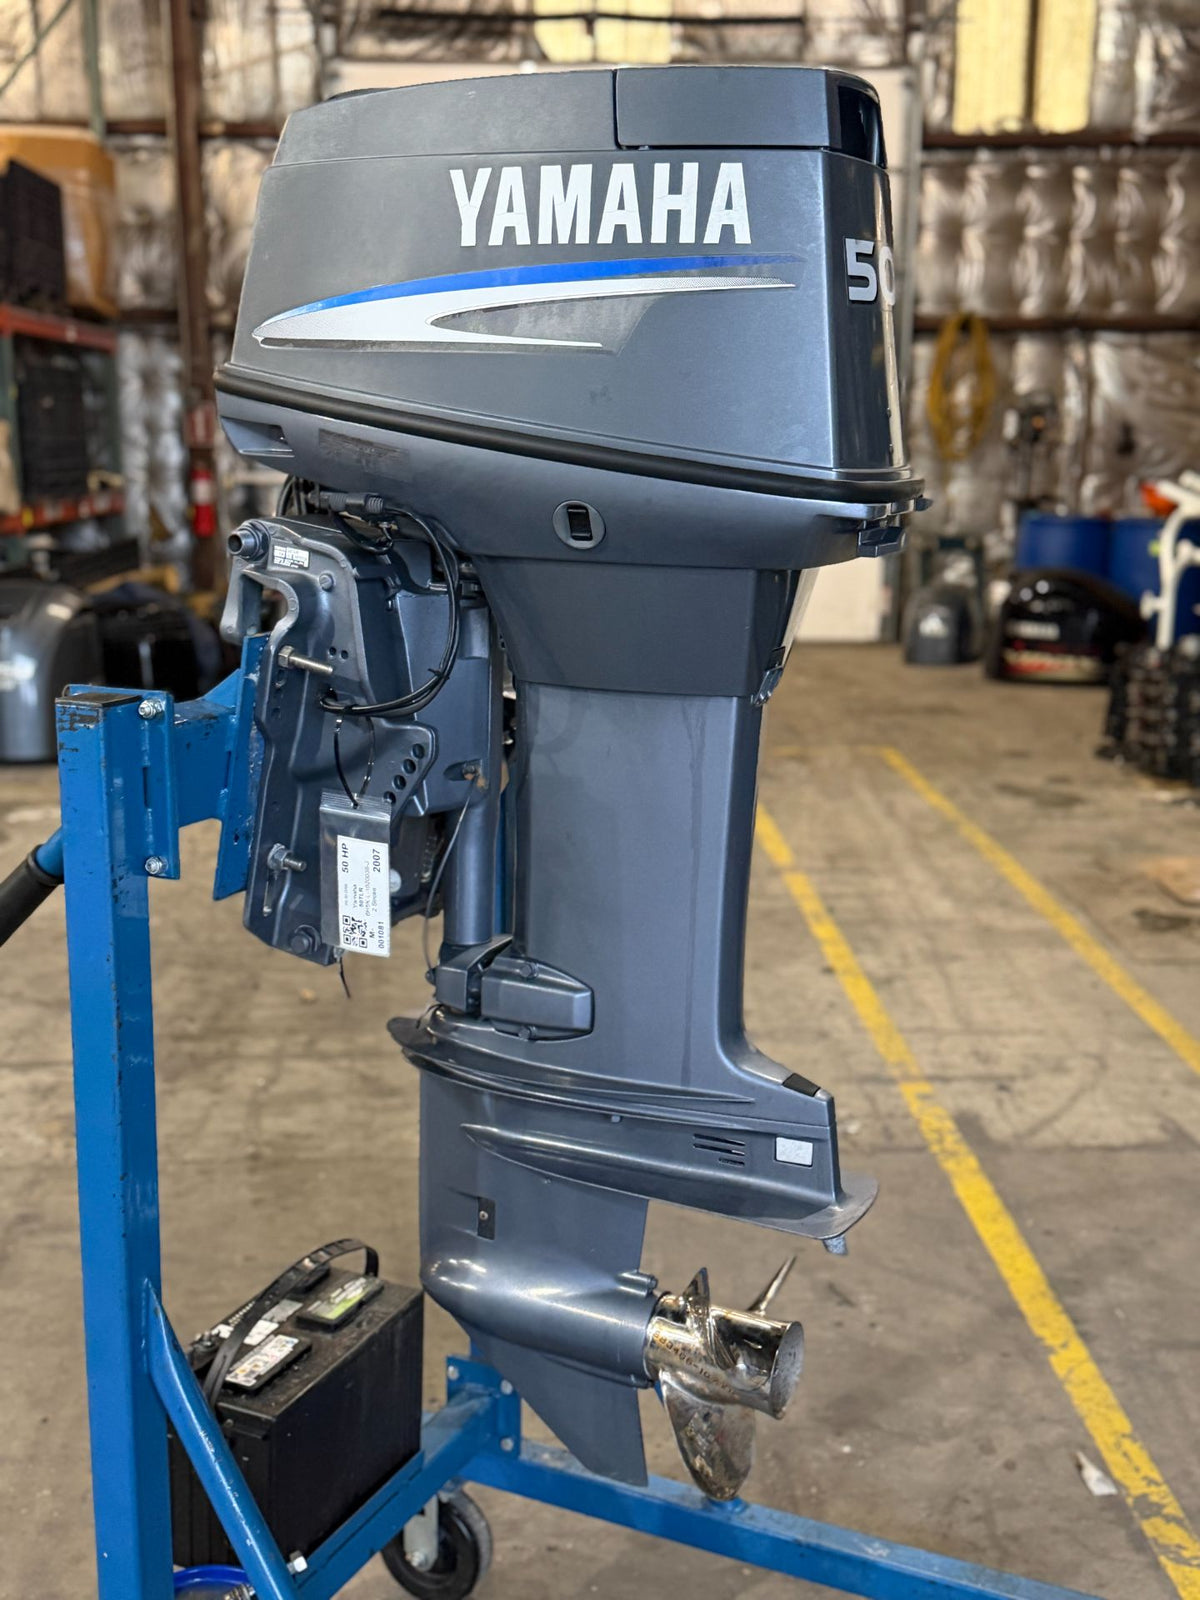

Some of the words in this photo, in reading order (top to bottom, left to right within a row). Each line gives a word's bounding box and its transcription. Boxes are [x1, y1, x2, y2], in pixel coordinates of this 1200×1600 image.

[450, 162, 751, 247] YAMAHA
[845, 238, 895, 305] 50
[342, 843, 349, 857] HP
[372, 849, 380, 872] 2007
[342, 860, 349, 873] 50
